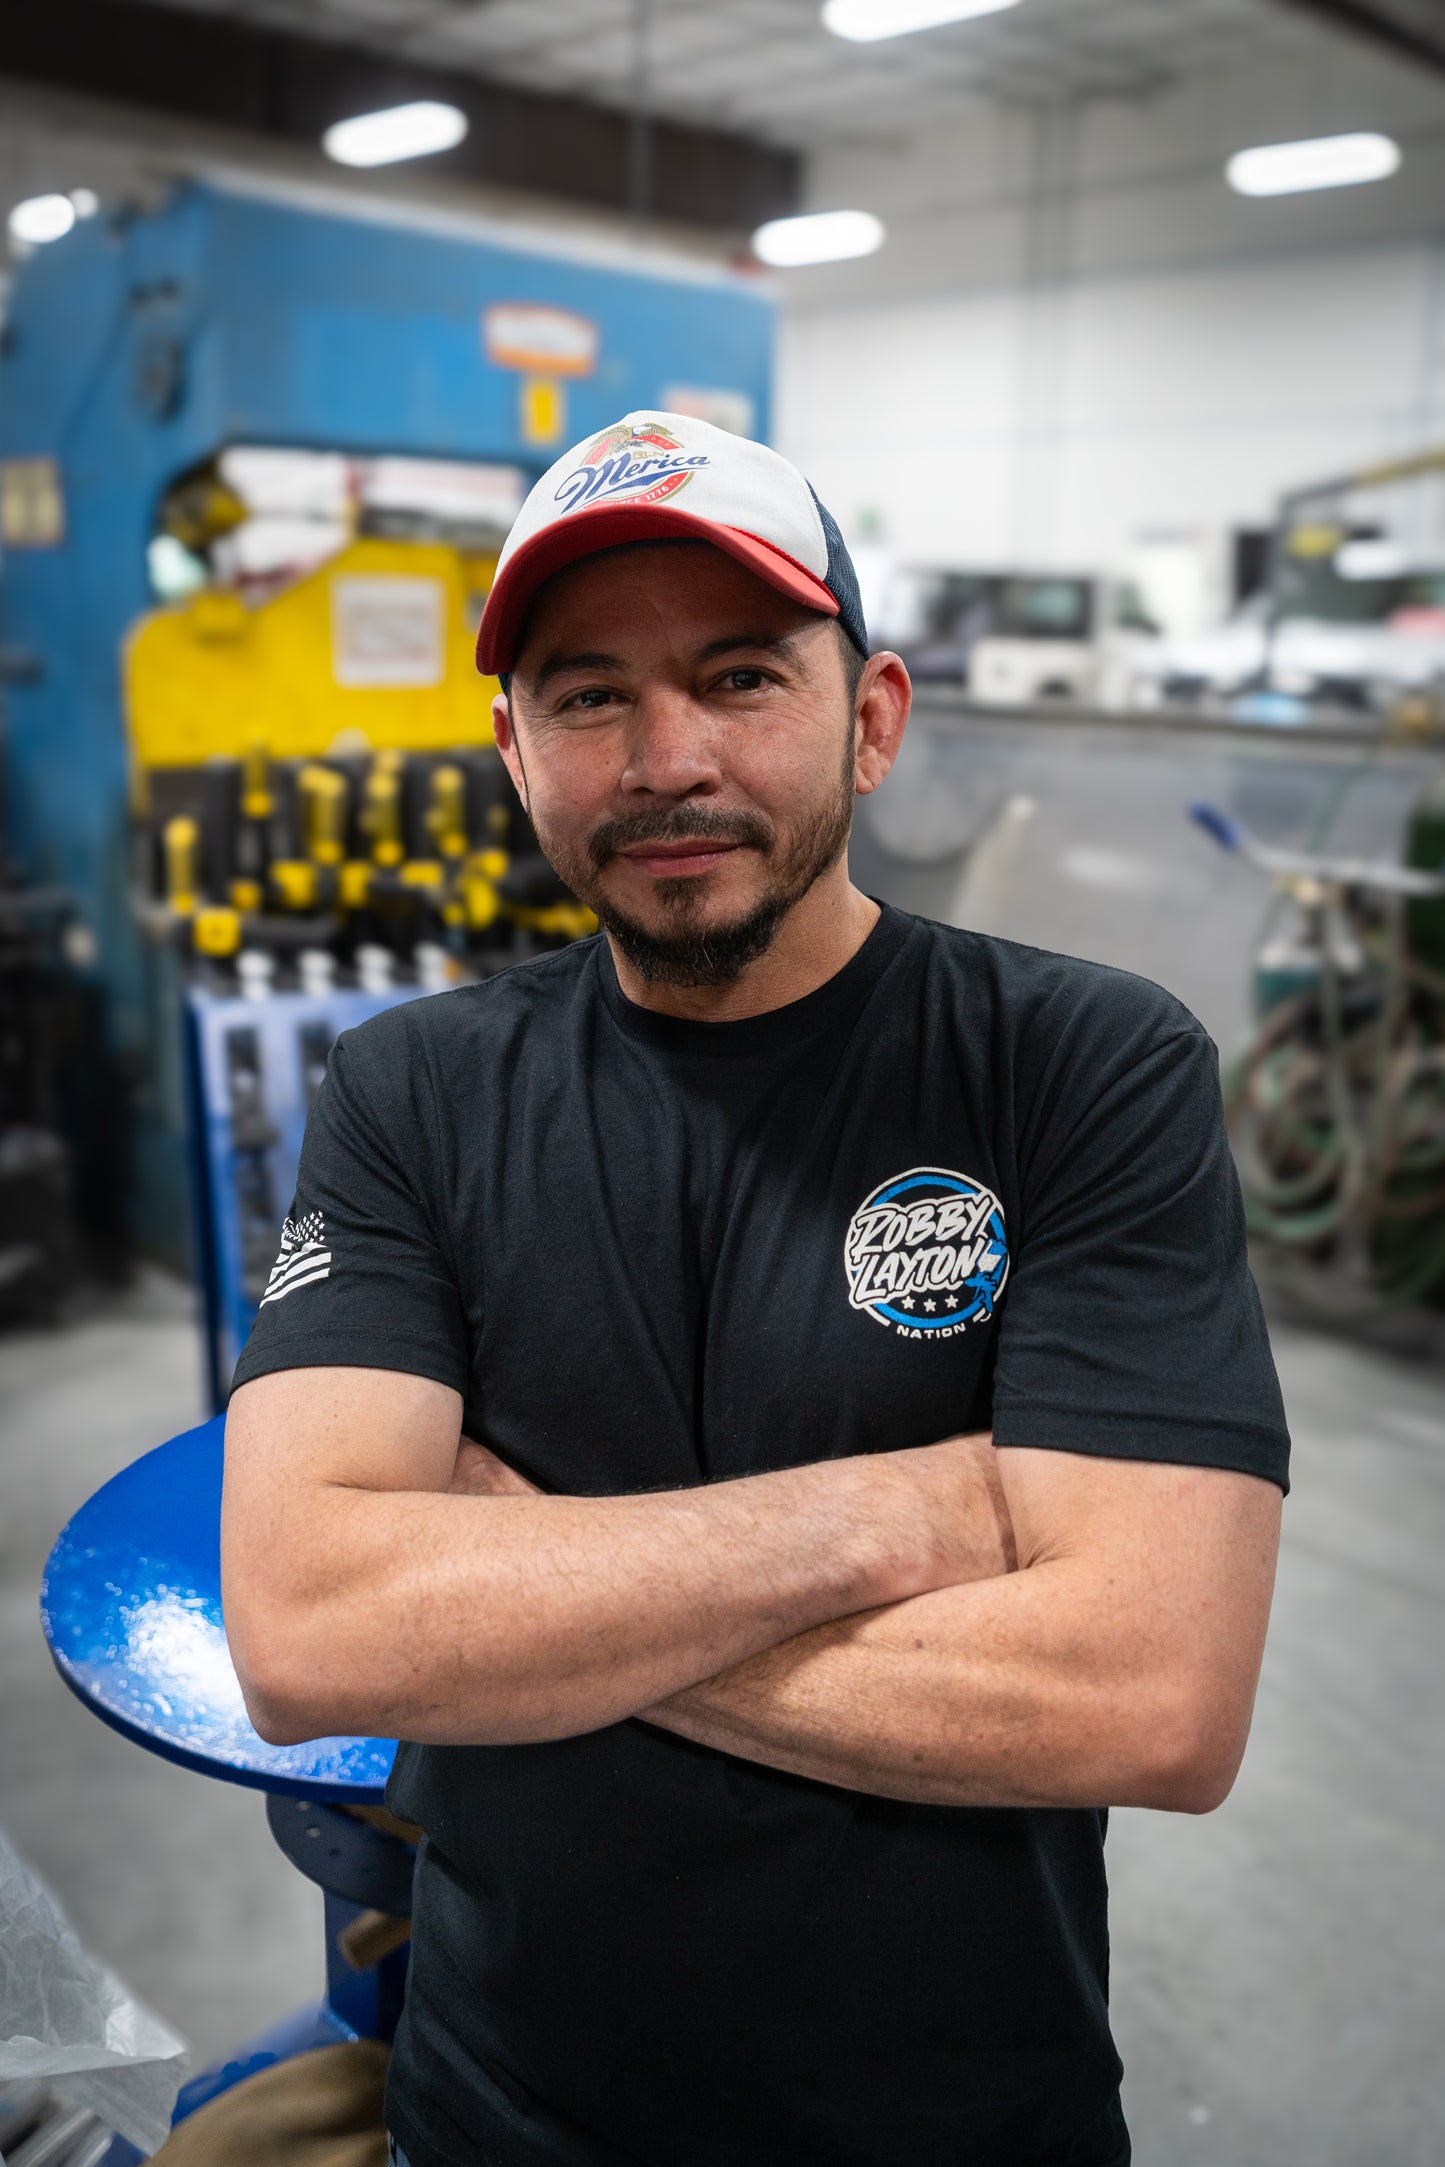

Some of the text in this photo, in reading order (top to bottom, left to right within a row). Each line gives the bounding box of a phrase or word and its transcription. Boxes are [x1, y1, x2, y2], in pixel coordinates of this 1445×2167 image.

[554, 452, 711, 515] Merica
[645, 485, 669, 501] 1776
[850, 1197, 991, 1264] ROBBY
[855, 1237, 986, 1303] LAYTON
[896, 1322, 967, 1340] NATION
